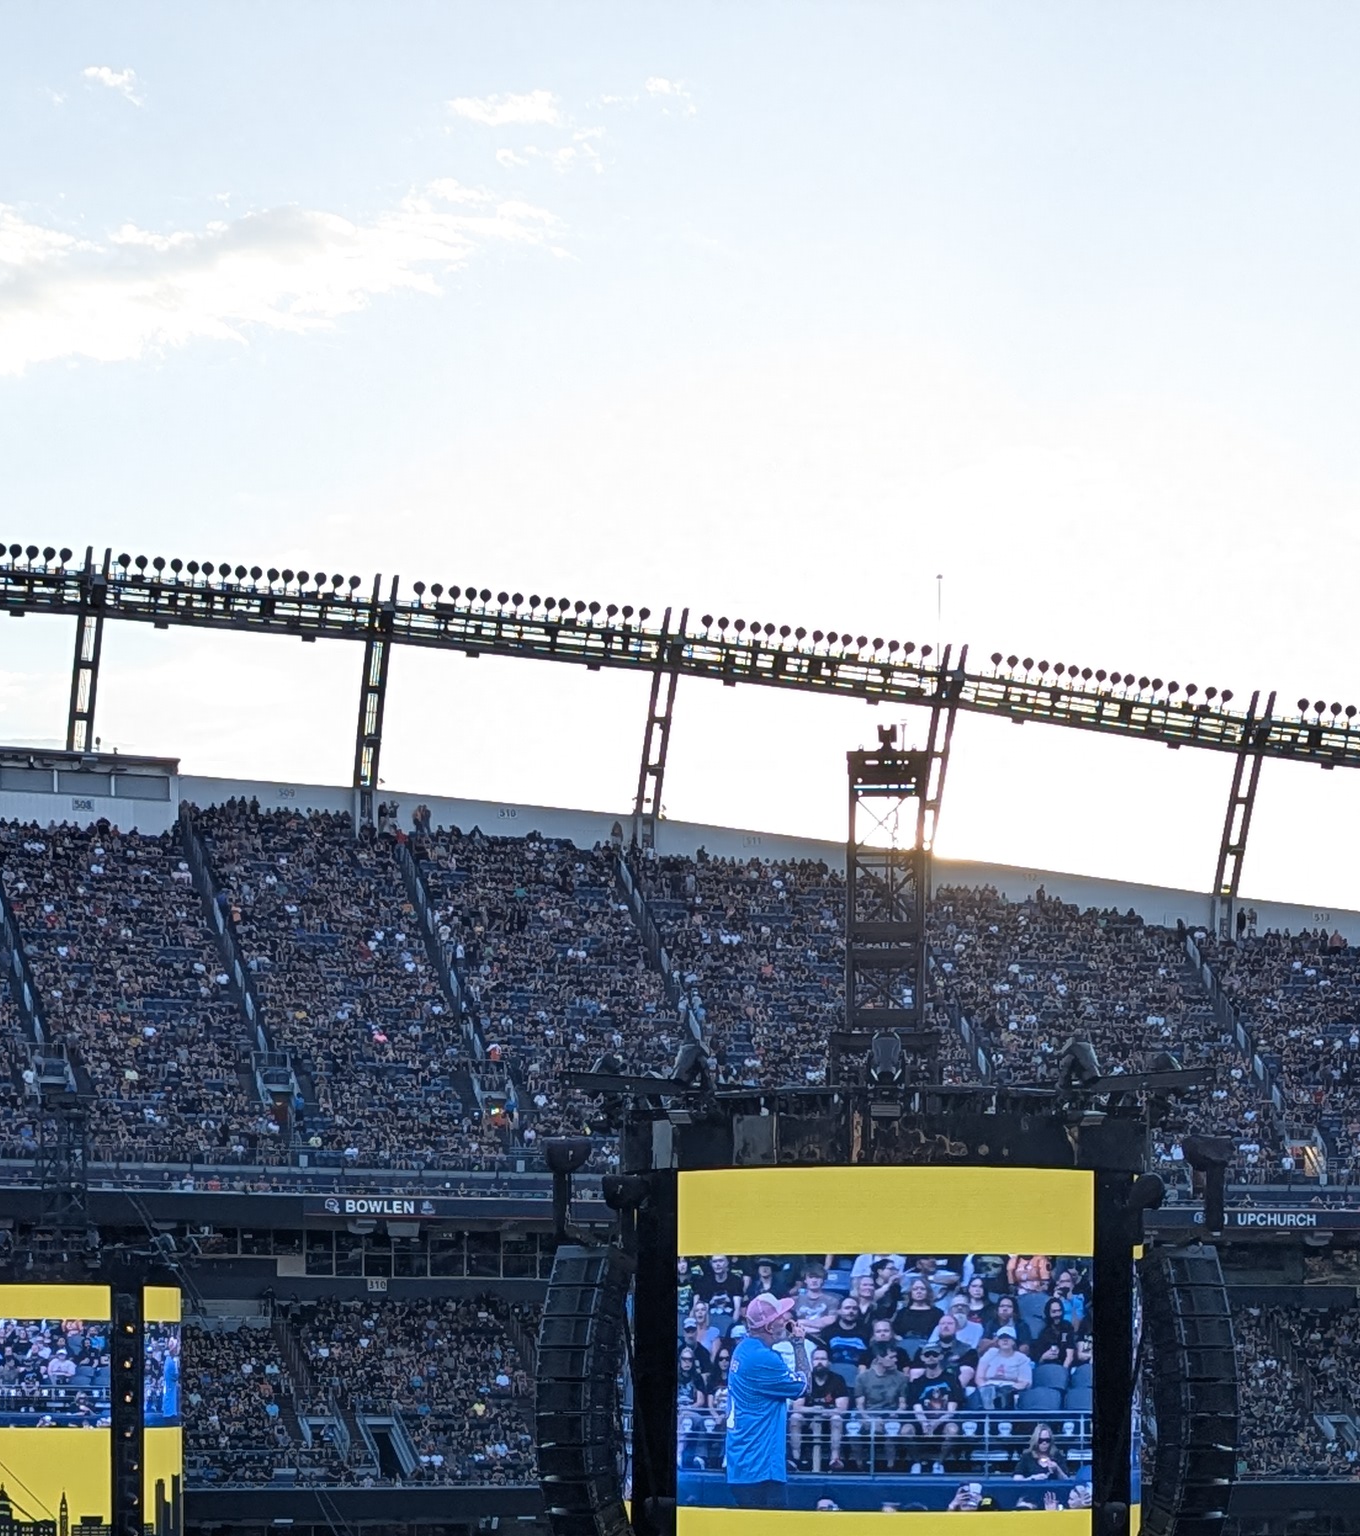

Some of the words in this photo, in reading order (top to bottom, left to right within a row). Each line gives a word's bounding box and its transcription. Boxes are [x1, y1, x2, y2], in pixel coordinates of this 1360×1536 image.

[278, 788, 295, 797] 509
[74, 800, 92, 809] 508
[499, 809, 517, 818] 510
[746, 836, 761, 845] 511
[1314, 913, 1330, 921] 513
[345, 1200, 415, 1214] BOWLEN
[1237, 1213, 1317, 1226] UPCHURCH
[369, 1280, 386, 1290] 310
